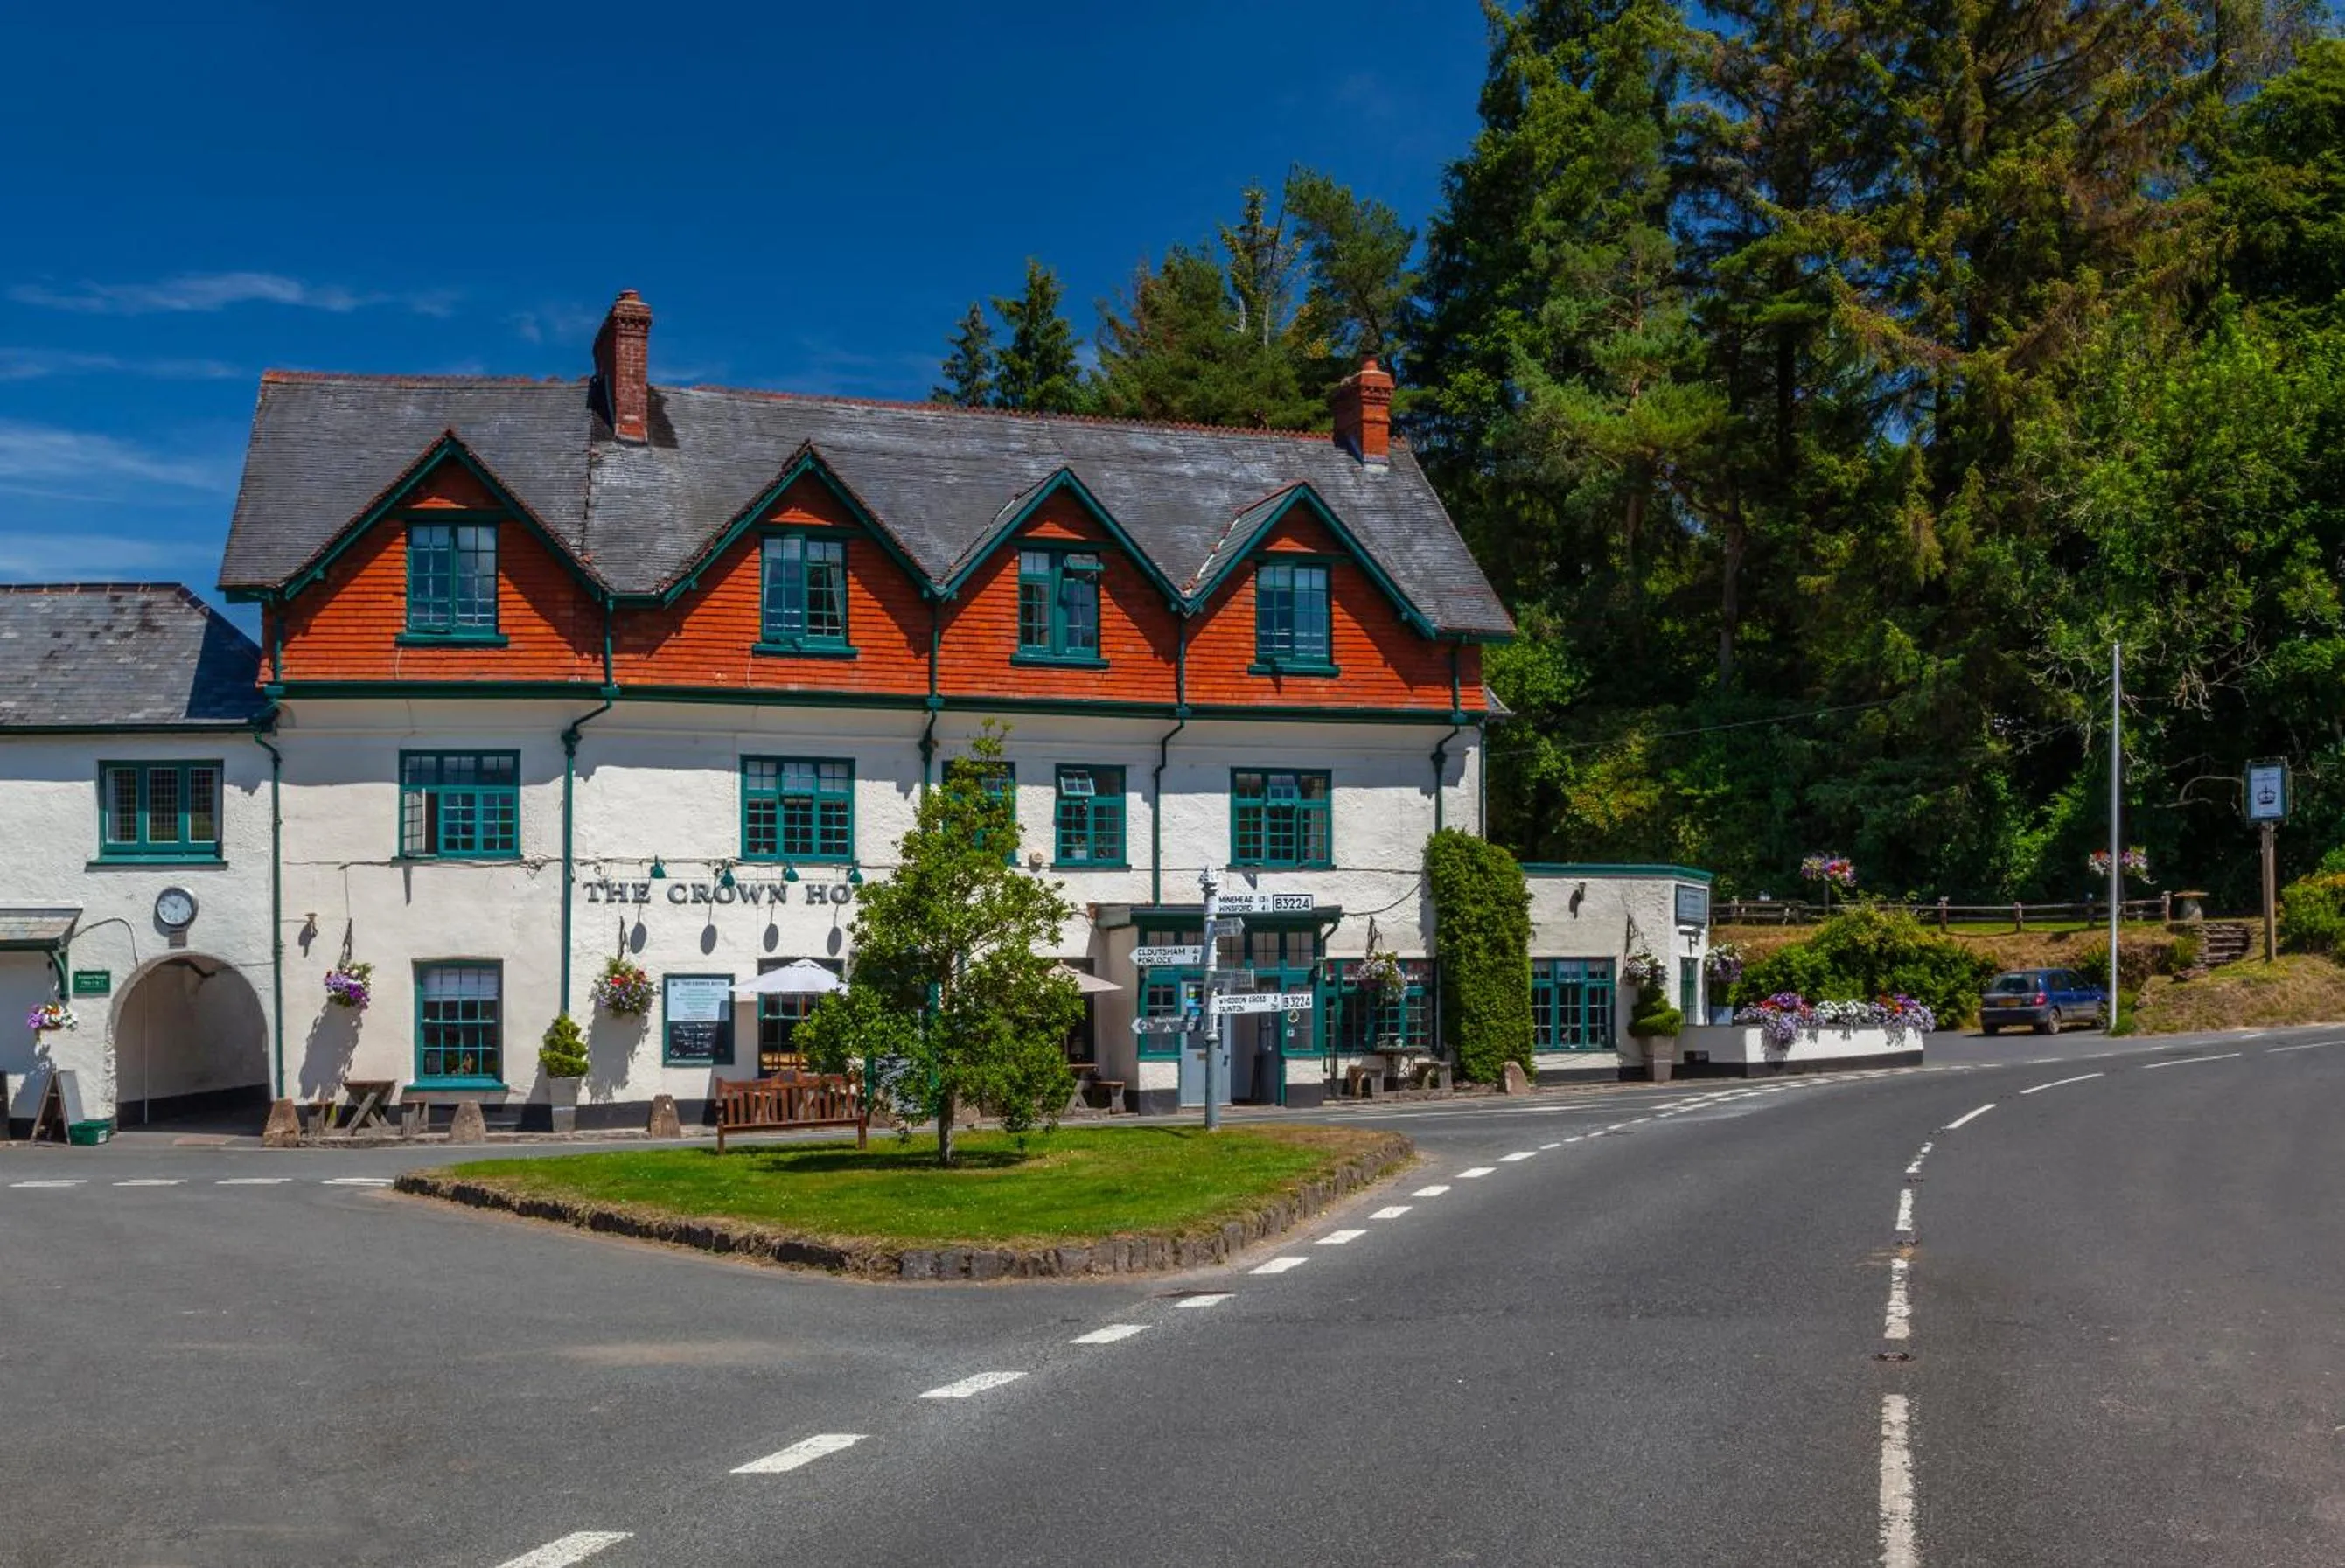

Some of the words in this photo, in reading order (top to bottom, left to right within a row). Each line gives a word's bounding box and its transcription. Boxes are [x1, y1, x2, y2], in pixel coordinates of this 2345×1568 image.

[583, 881, 651, 904] THE
[667, 882, 788, 905] CROWN
[1218, 895, 1253, 903] MINEHEAD
[1274, 897, 1310, 909] B3224
[1137, 947, 1186, 956] CLOUTSHAM
[1137, 956, 1173, 965] PORLOCK
